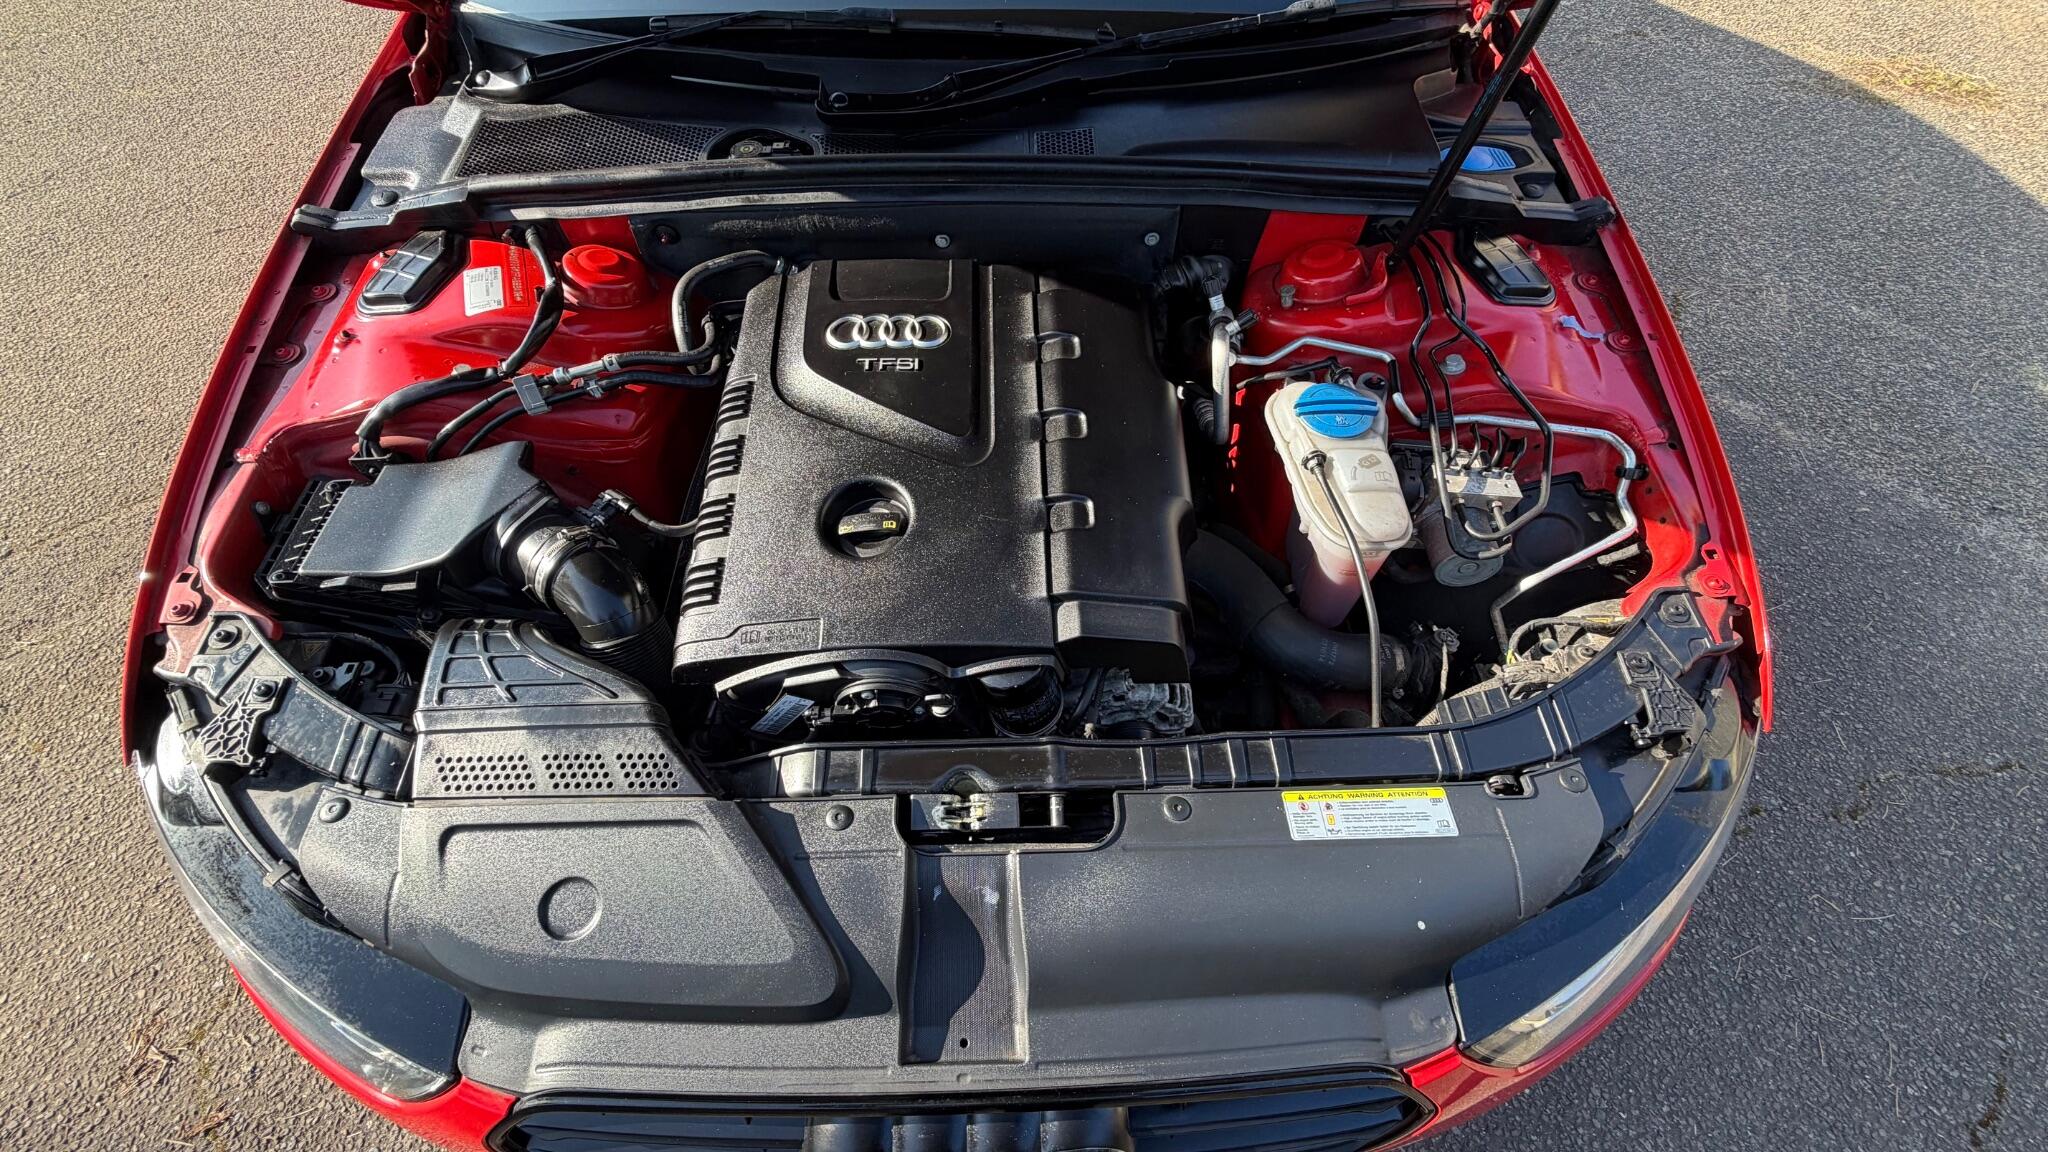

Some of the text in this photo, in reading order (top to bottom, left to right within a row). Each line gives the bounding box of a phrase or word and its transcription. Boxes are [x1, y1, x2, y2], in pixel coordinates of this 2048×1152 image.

[856, 358, 920, 371] TFSI
[1347, 791, 1384, 799] WARNING
[1387, 790, 1429, 798] ATTENTION
